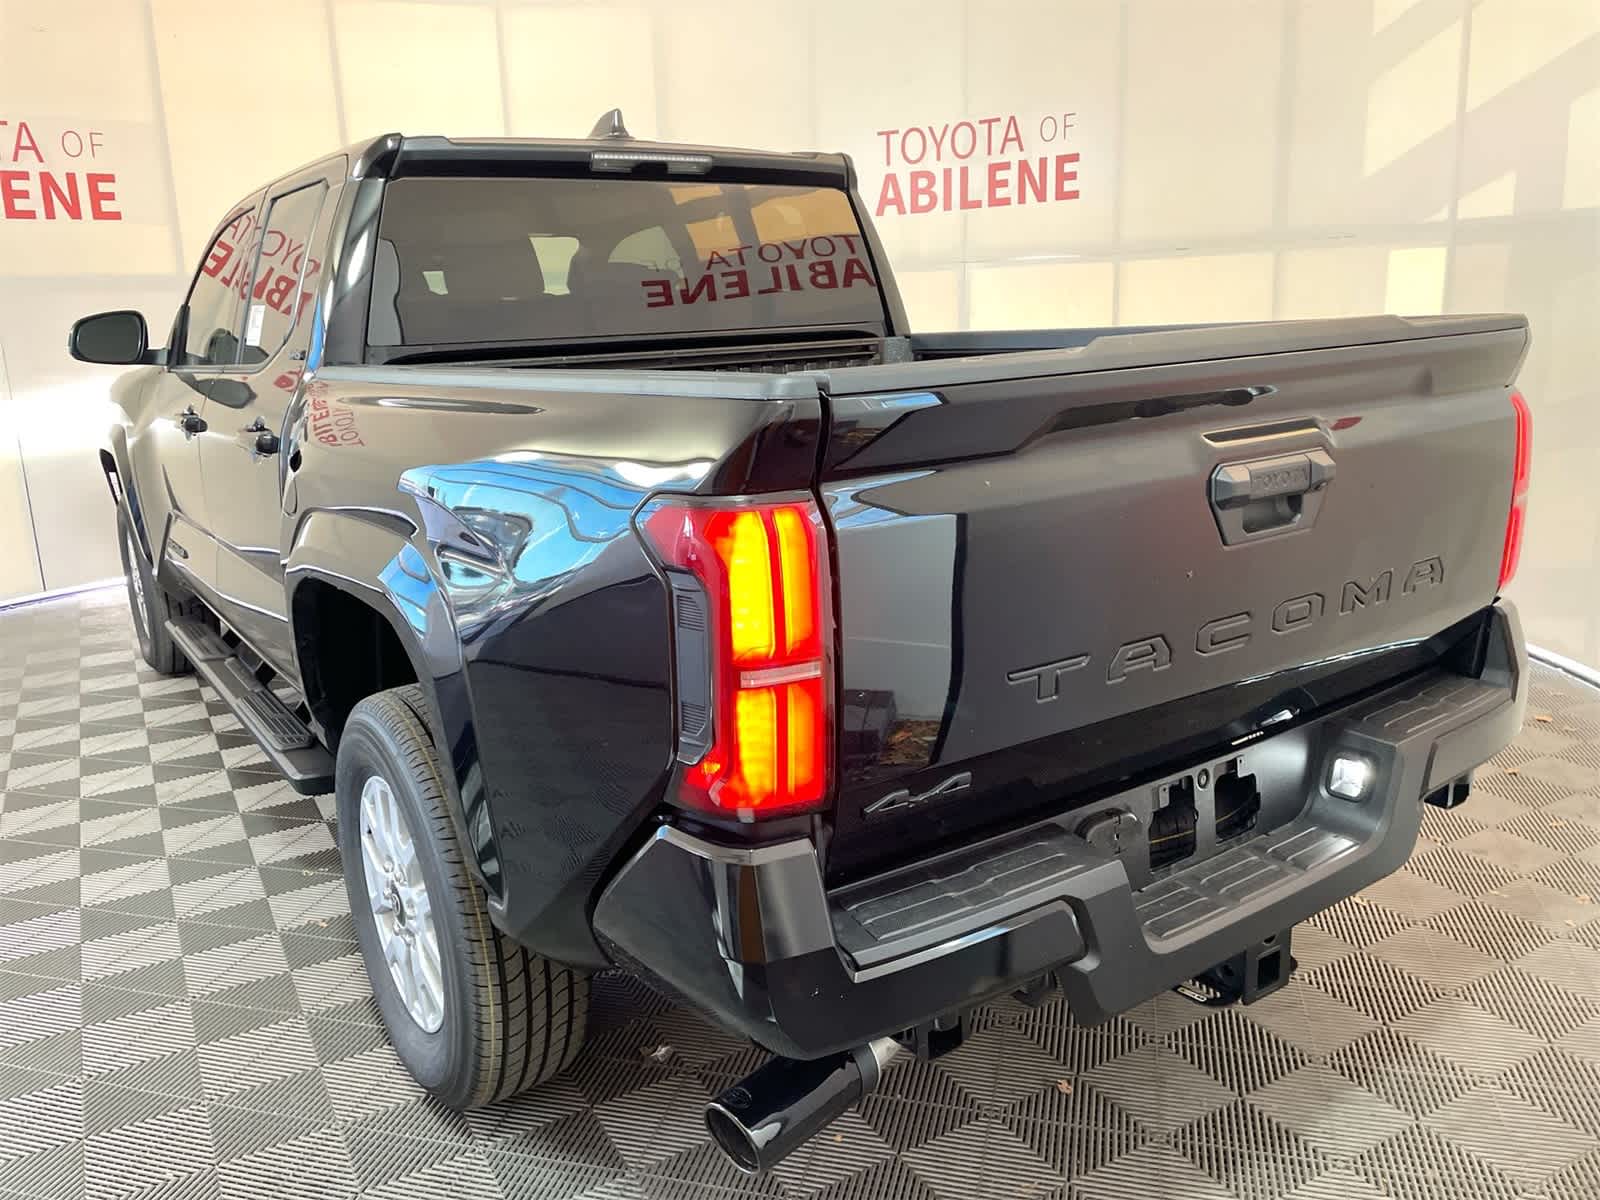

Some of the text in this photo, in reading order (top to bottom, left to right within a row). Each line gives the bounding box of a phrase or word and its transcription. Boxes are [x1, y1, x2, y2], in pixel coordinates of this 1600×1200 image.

[61, 130, 104, 159] OF
[877, 112, 1077, 167] TOYOTA OF
[875, 153, 1081, 217] ABILENE
[1006, 555, 1446, 703] TACOMA
